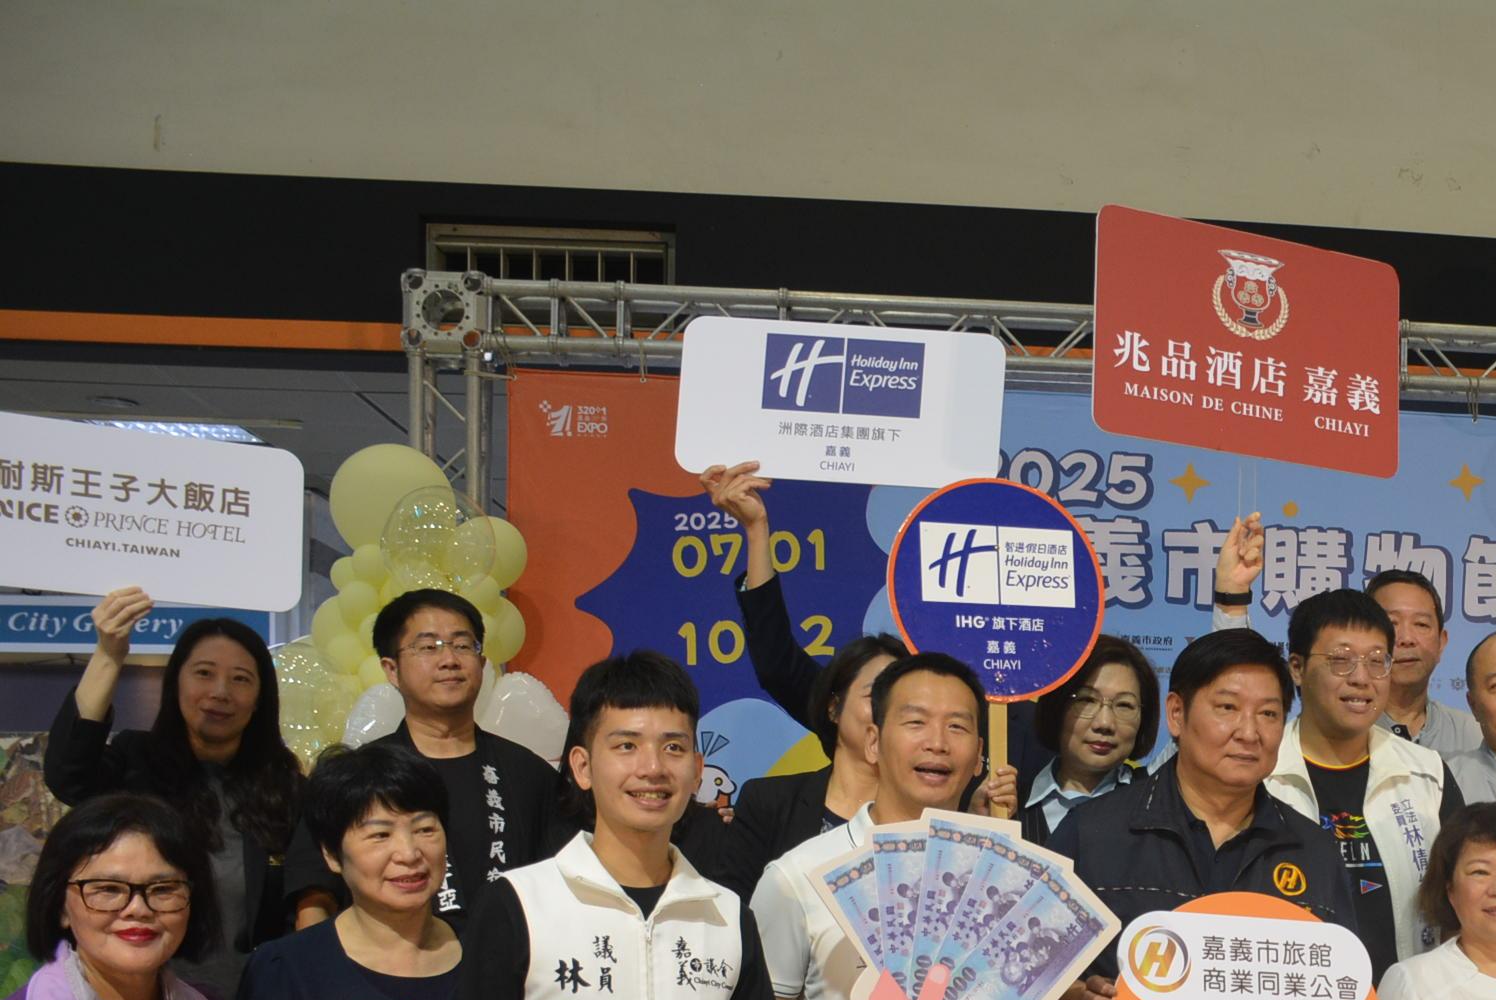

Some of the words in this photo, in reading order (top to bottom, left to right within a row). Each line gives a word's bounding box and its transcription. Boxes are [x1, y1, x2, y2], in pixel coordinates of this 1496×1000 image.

[850, 354, 899, 372] Holiday
[899, 357, 919, 371] Inn
[1113, 330, 1287, 397] 兆品酒店
[1303, 364, 1381, 416] 嘉義
[850, 370, 918, 391] Express
[1123, 381, 1194, 407] MAISON
[1202, 395, 1225, 412] DE
[1230, 400, 1284, 423] CHINE
[1313, 416, 1370, 438] CHIAYI
[577, 422, 608, 433] EXPO
[778, 421, 902, 442] 洲際酒店集團旗下
[825, 445, 851, 458] 嘉義
[819, 460, 855, 471] CHIAYI
[998, 450, 1148, 503] 025
[0, 459, 250, 518] 耐斯王子大飯店
[94, 511, 169, 535] PRINCE
[176, 520, 246, 544] HOTEL
[674, 512, 738, 531] 2025
[65, 536, 181, 558] CHIAYI.TAIWAN
[1004, 555, 1049, 571] Holiday
[1050, 559, 1068, 570] Inn
[1005, 570, 1070, 591] Express
[8, 611, 67, 638] City
[73, 612, 184, 640] Gery
[992, 617, 1045, 632] 旗下酒店
[986, 640, 1016, 655] 嘉義
[983, 658, 1022, 670] CHIAYI
[1202, 935, 1332, 969] 嘉義市旅館
[593, 935, 617, 993] 議員
[1202, 967, 1359, 1000] 商業同業公會
